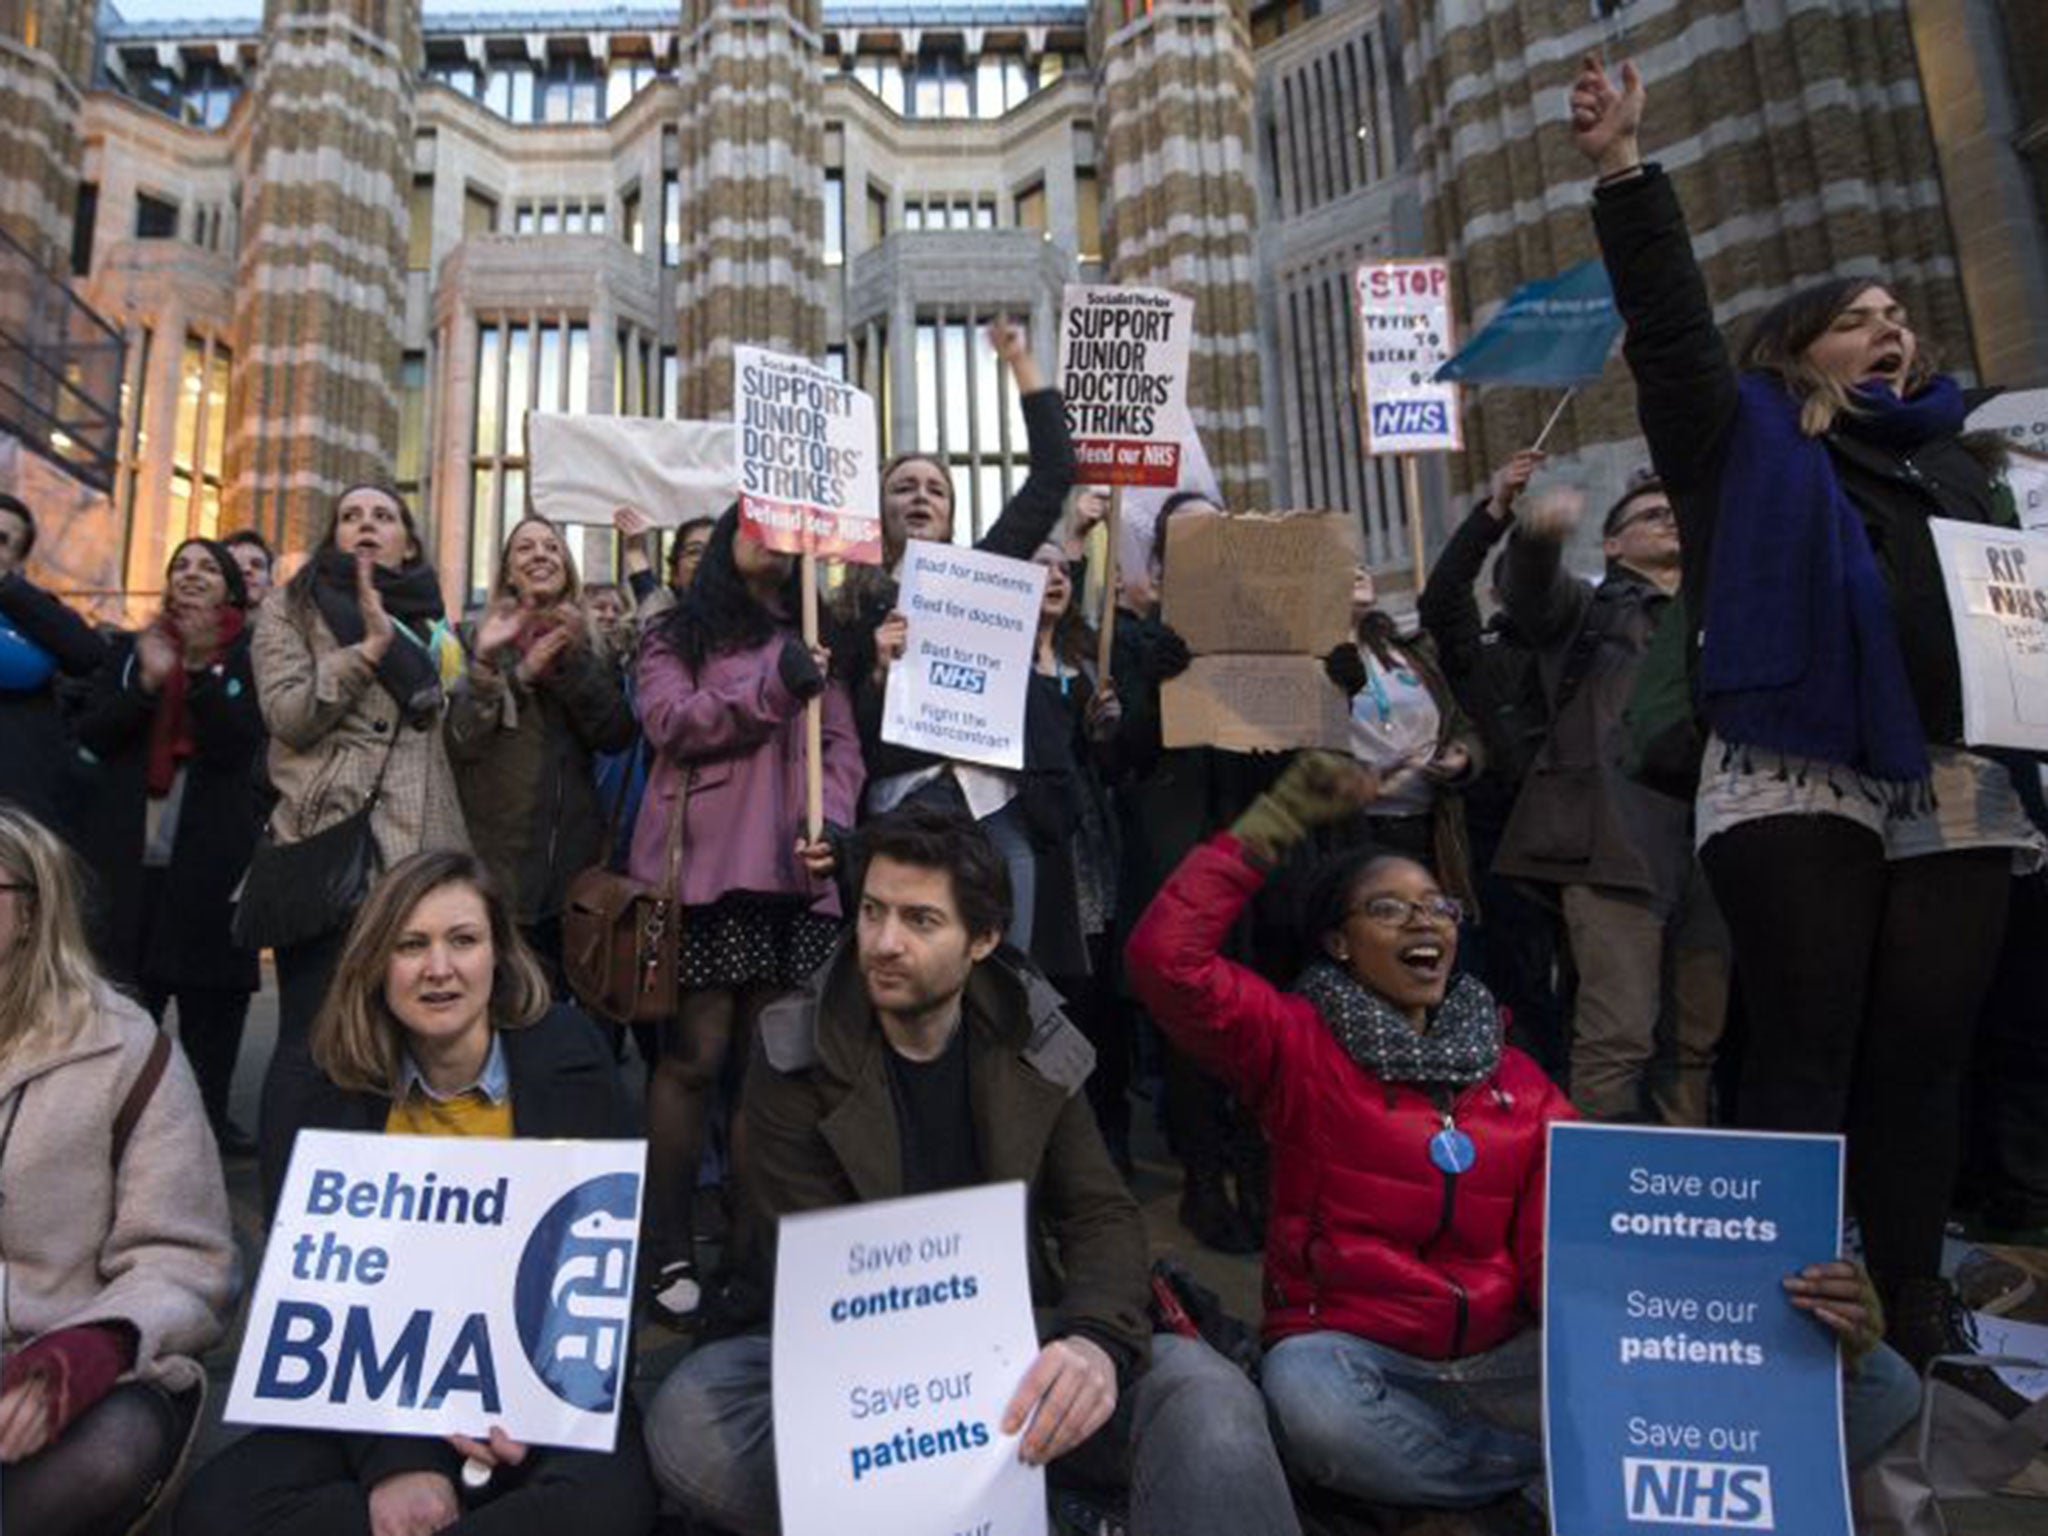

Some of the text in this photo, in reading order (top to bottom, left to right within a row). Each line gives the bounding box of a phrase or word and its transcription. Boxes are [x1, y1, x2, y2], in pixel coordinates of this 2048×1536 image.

[1371, 269, 1446, 298] STOP
[1068, 307, 1174, 342] SUPPORT
[1414, 333, 1439, 347] TO
[1065, 340, 1147, 373] JUNIOR
[742, 365, 855, 418] SUPPORT
[1064, 372, 1174, 406] DOCTORS'
[743, 397, 828, 443] JUNIOR
[1063, 403, 1156, 436] STRIKES
[1377, 404, 1442, 435] NHS
[1143, 444, 1176, 468] NHS
[743, 460, 846, 508] STRIKES
[914, 556, 1034, 595] Bad for patients
[1985, 546, 2026, 584] RIP
[946, 598, 966, 617] for
[968, 606, 1024, 632] doctors
[1987, 585, 2048, 624] NHS
[920, 640, 1001, 671] Bad for the
[931, 662, 985, 692] NHS
[305, 1168, 509, 1226] Behind
[1628, 1167, 1762, 1200] Save our
[1610, 1211, 1778, 1243] contracts
[292, 1231, 390, 1286] the
[848, 1233, 963, 1276] Save our
[829, 1273, 980, 1323] contracts
[1626, 1290, 1758, 1323] Save our
[253, 1299, 503, 1415] BMA
[1620, 1333, 1764, 1366] patients
[850, 1371, 973, 1420] Save our
[850, 1419, 990, 1480] patients
[1627, 1416, 1761, 1452] Save our
[1630, 1463, 1764, 1522] NHS
